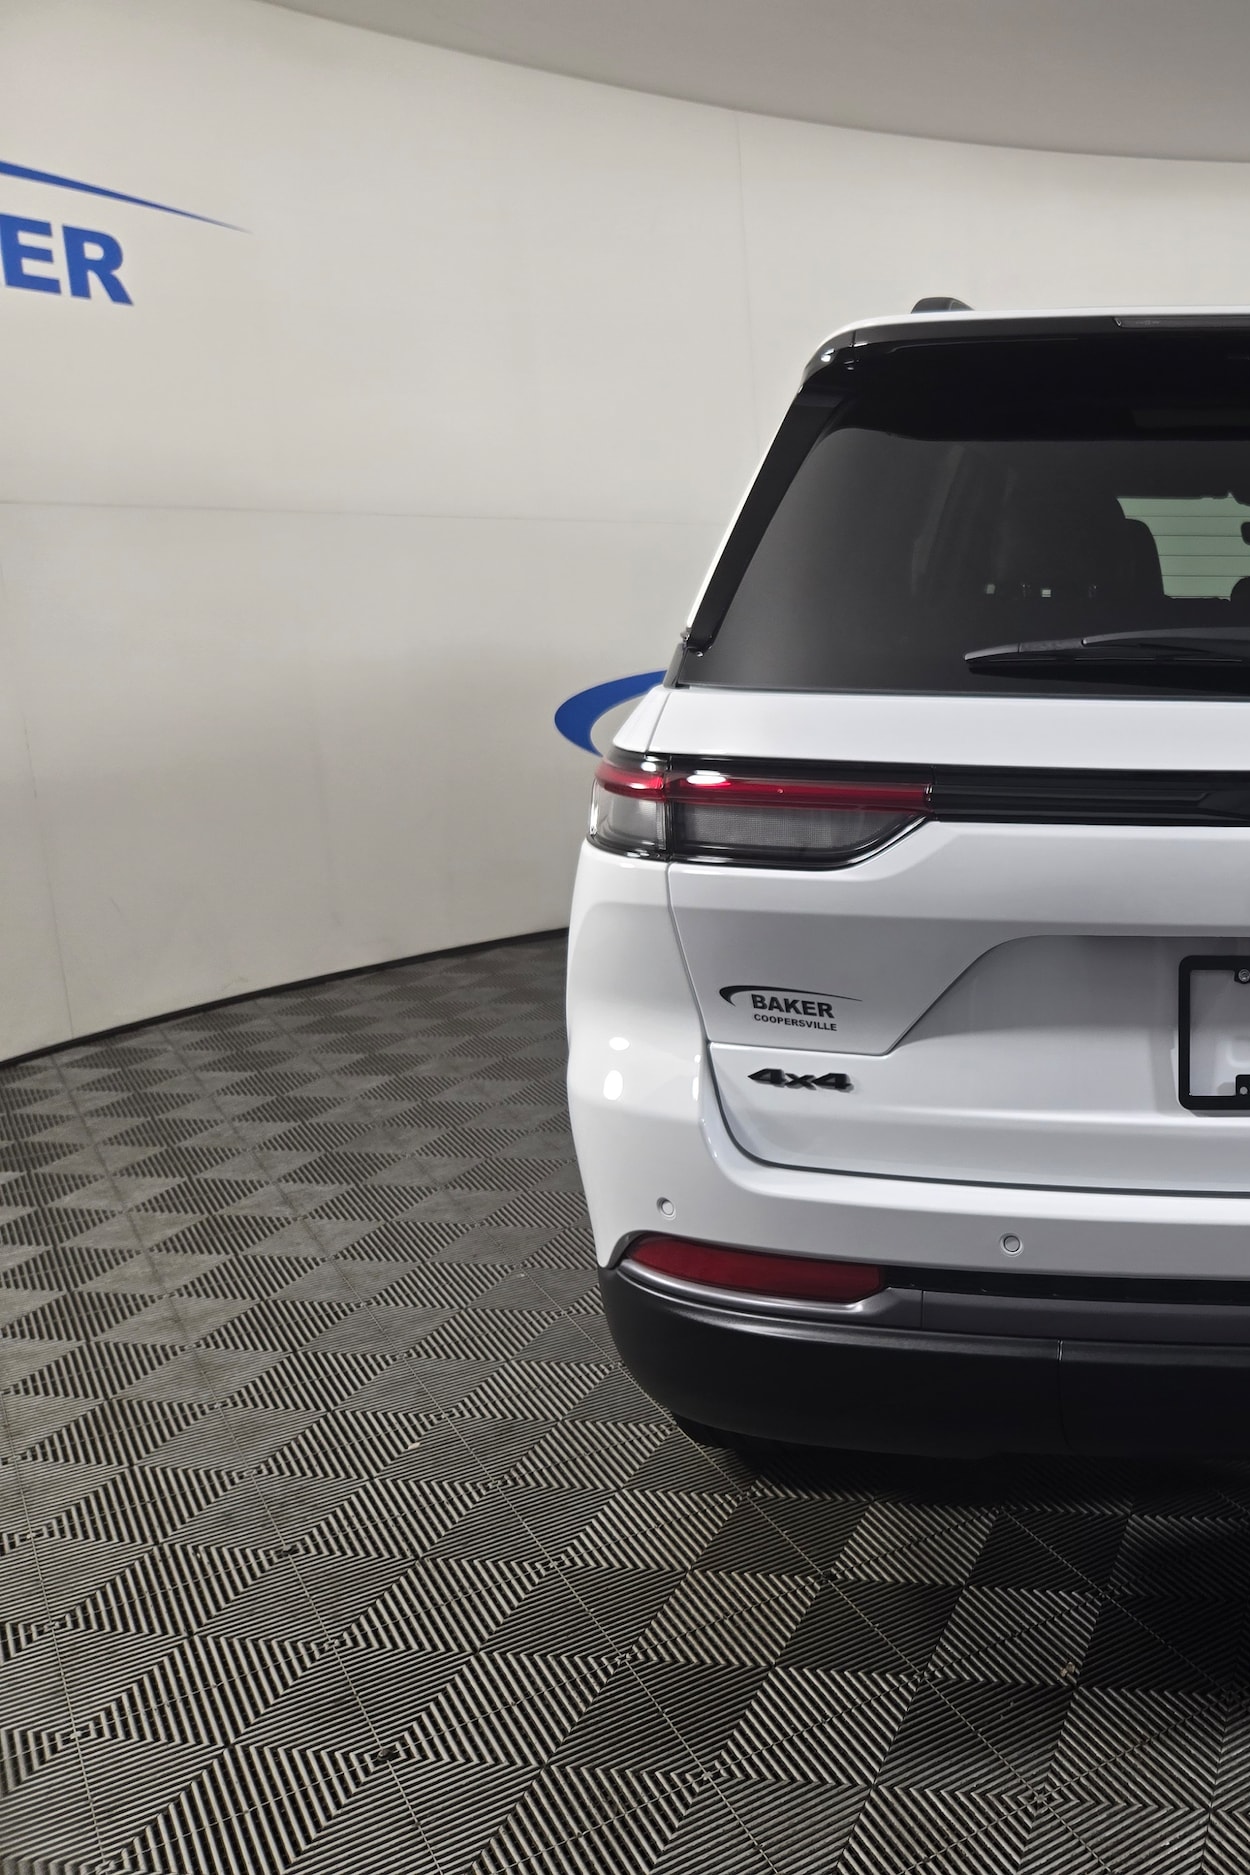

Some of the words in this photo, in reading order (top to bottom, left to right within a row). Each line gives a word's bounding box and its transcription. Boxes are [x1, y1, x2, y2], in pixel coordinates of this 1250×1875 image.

[751, 993, 835, 1019] BAKER
[754, 1013, 838, 1032] COOPERSVILLE
[747, 1068, 853, 1092] 4x4
